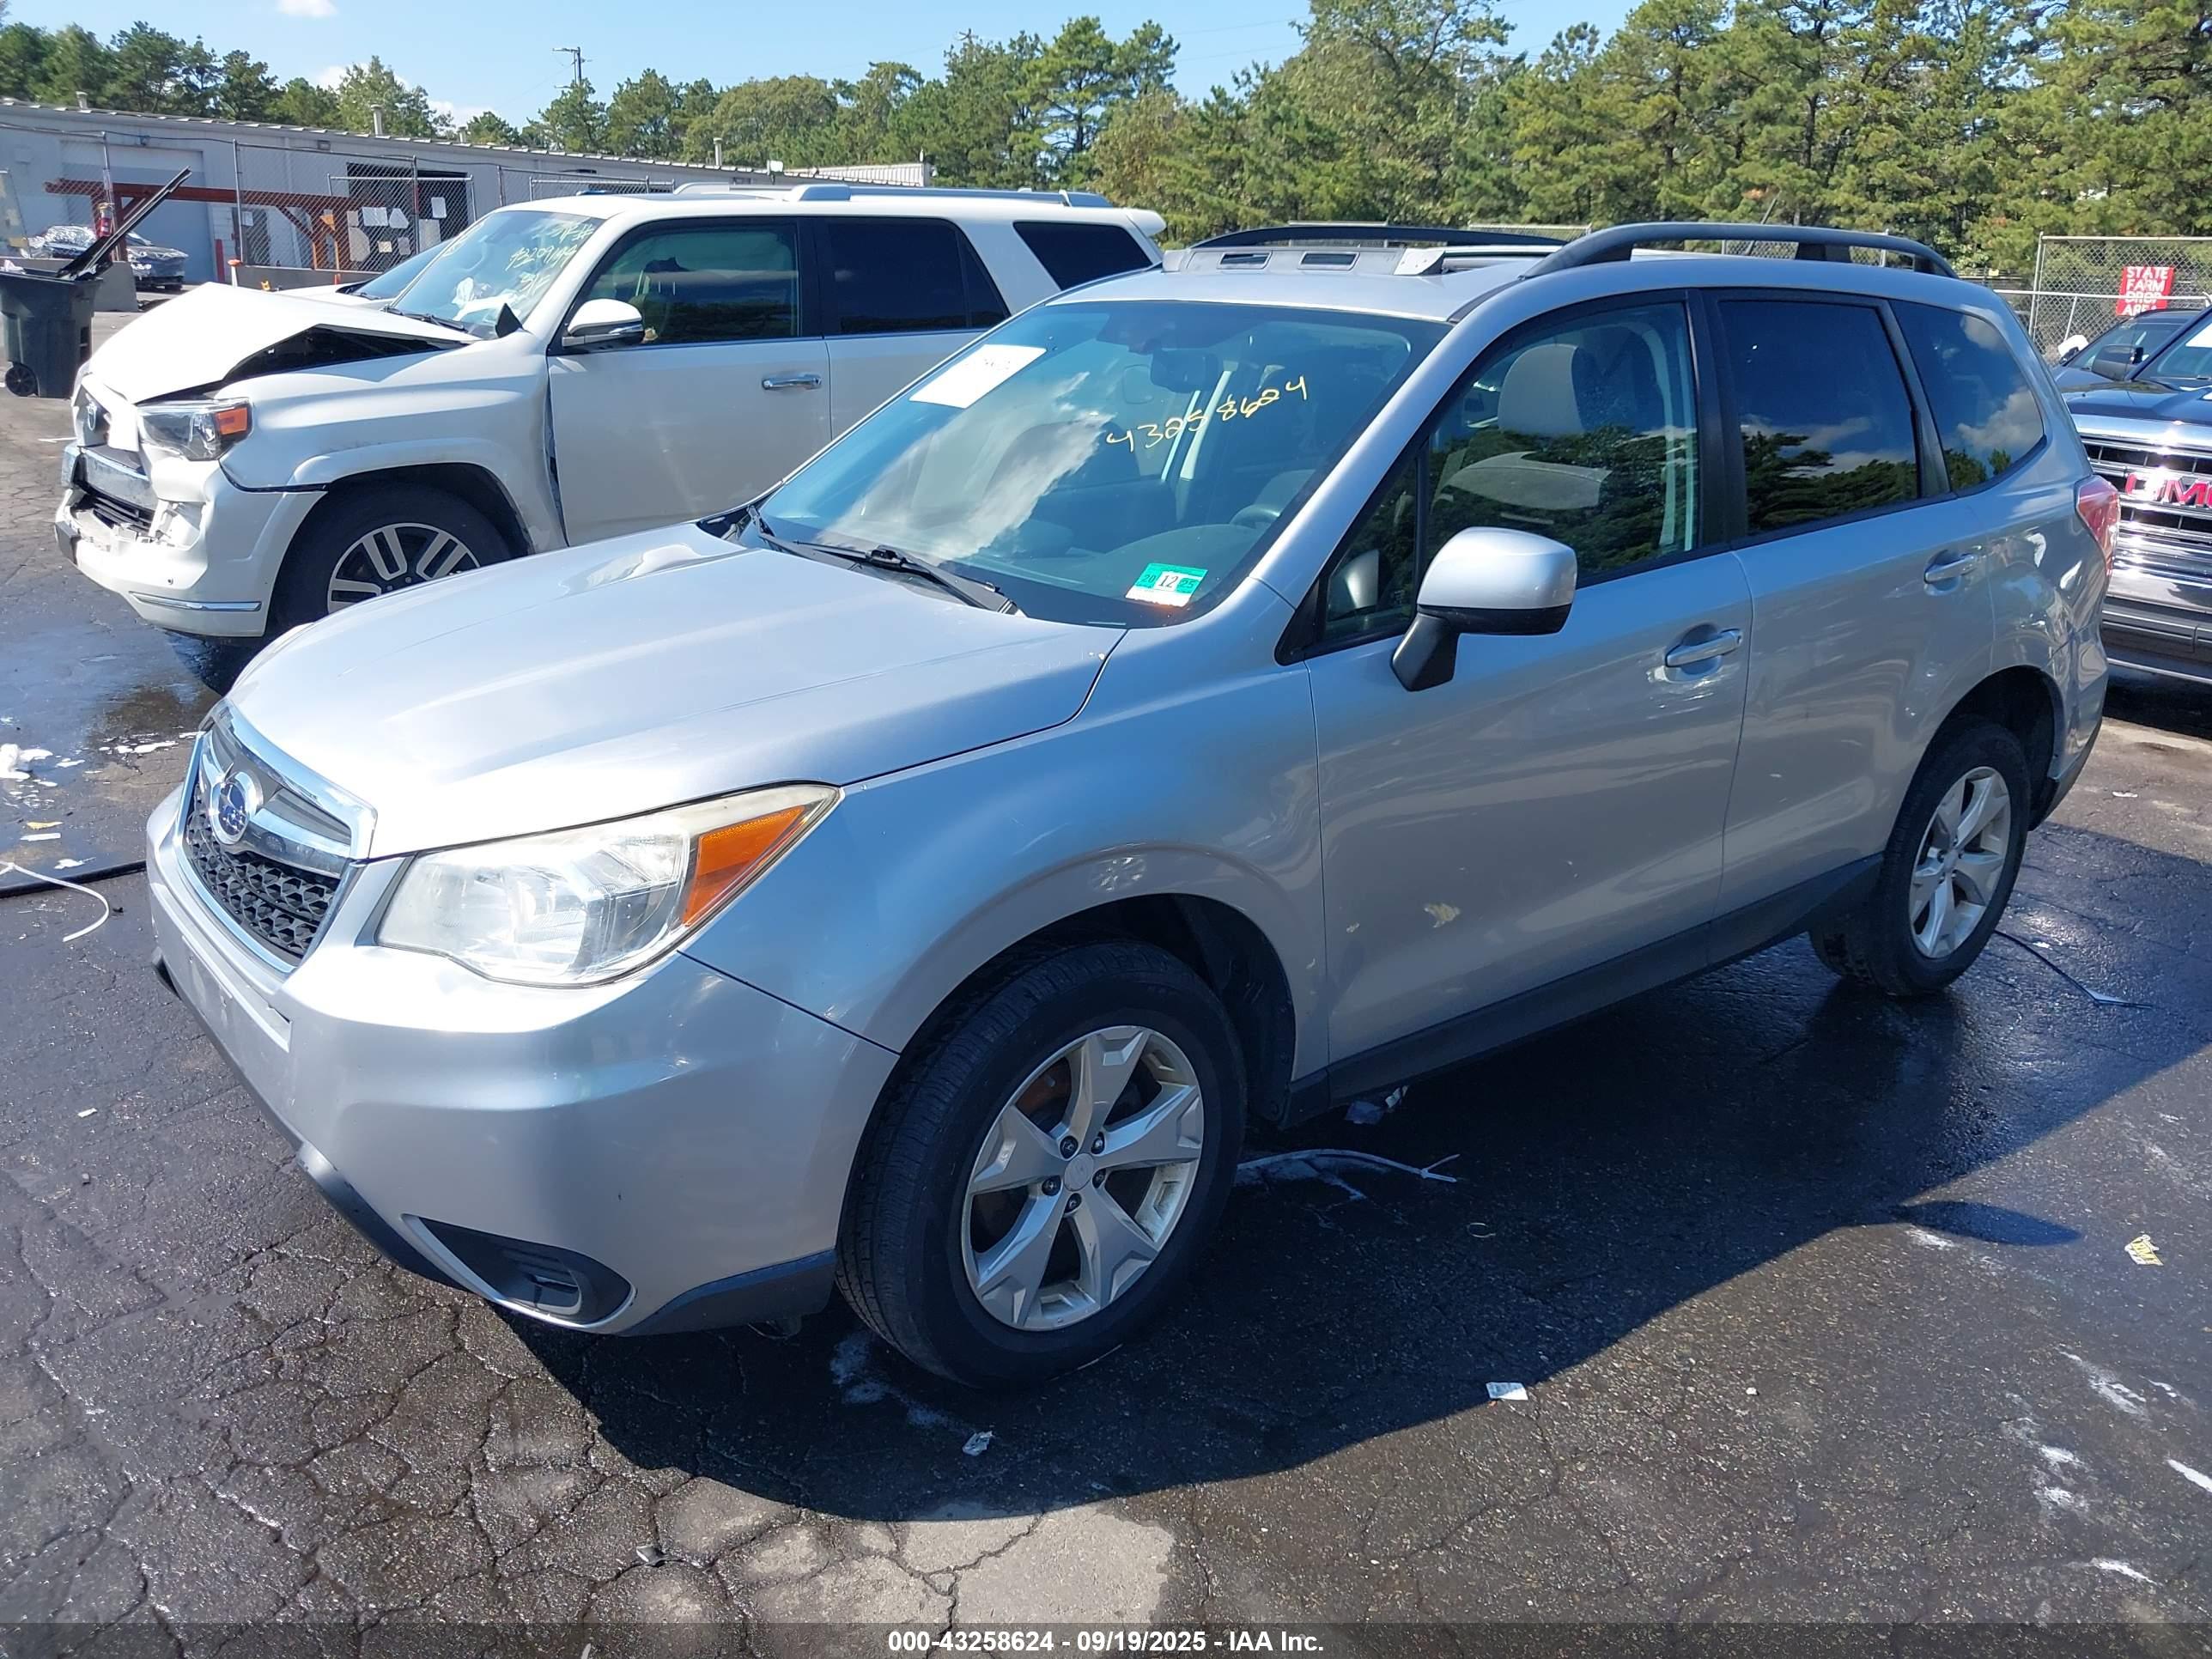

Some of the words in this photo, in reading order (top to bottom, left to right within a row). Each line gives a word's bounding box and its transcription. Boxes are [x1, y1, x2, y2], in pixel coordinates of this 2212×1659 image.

[2126, 266, 2169, 279] STATE
[2126, 278, 2166, 292] FARM
[1106, 375, 1308, 453] 43258624
[1141, 574, 1156, 583] 20
[1158, 574, 1179, 588] 12
[1181, 580, 1196, 589] 25
